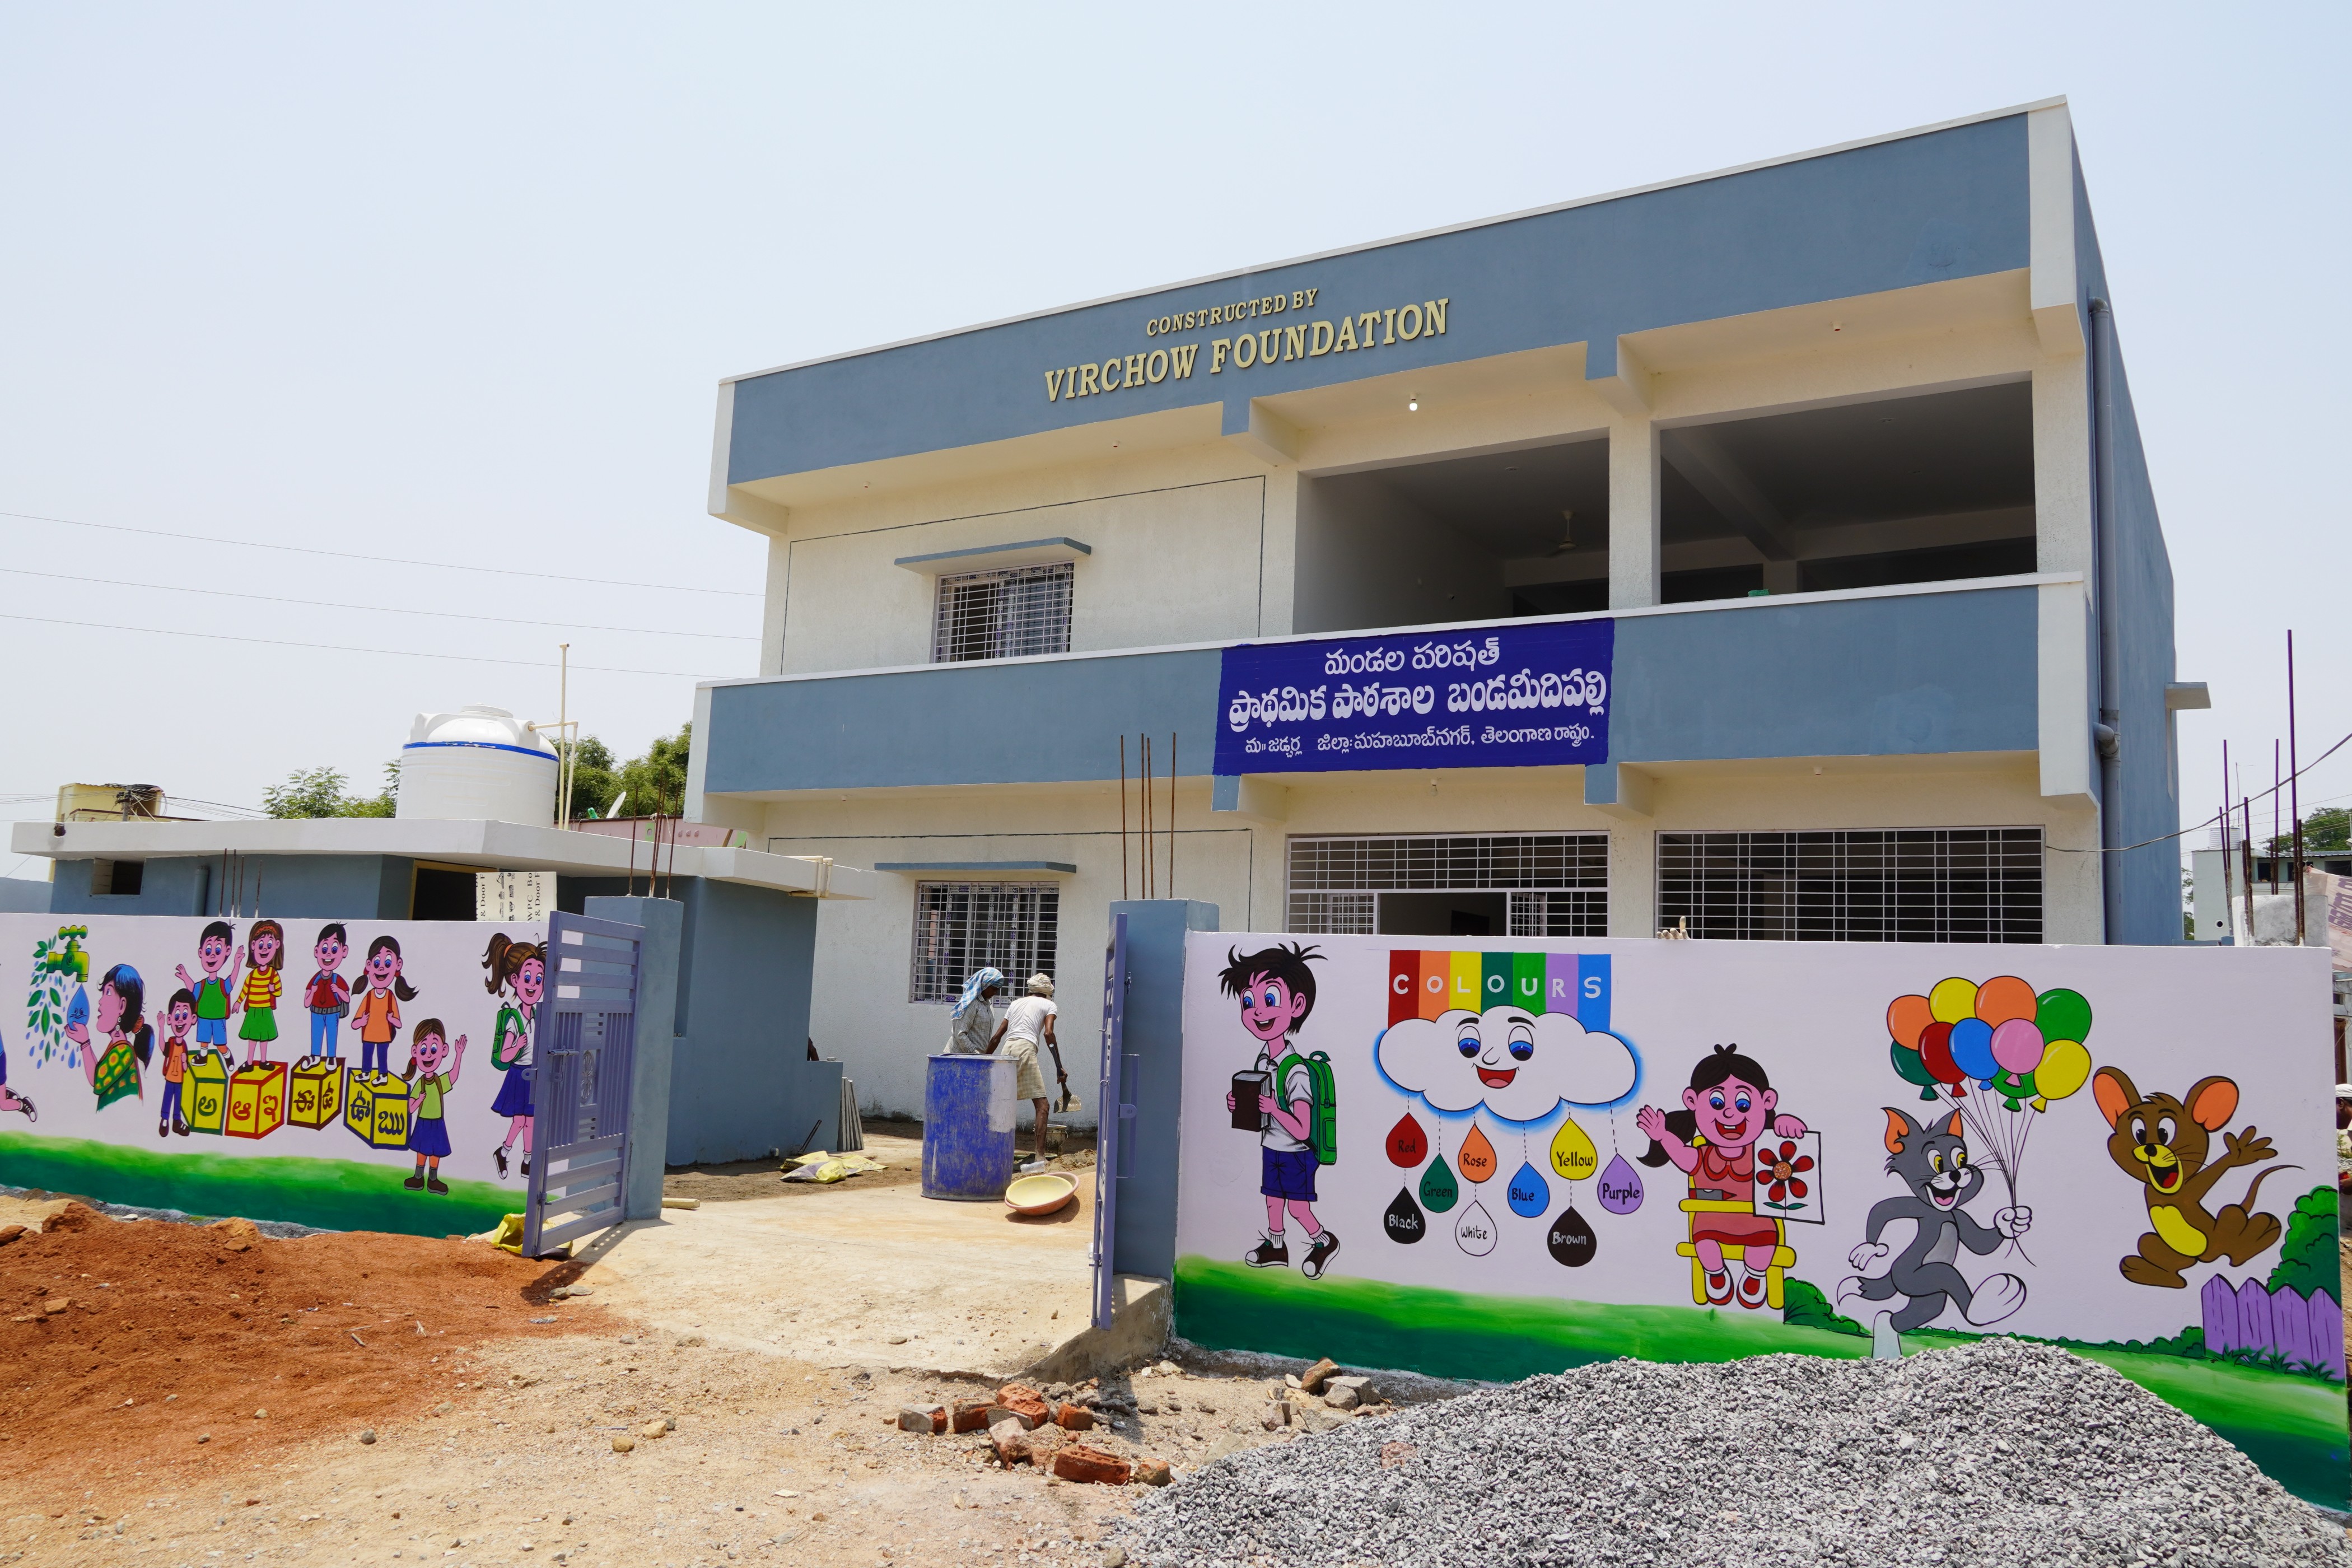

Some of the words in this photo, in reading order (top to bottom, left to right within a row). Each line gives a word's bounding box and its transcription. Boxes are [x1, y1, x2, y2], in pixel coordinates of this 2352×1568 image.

[1146, 294, 1287, 337] CONSTRUCTED
[1292, 288, 1318, 310] BY
[1044, 343, 1199, 402] VIRCHOW
[1210, 297, 1449, 374] FOUNDATION
[1324, 646, 1405, 675] మండల
[1412, 637, 1500, 672] పరిషత్
[1229, 684, 1327, 732] ప్రాథమిక
[1332, 682, 1435, 719] పాఠశాల
[1447, 668, 1607, 716] బండమీదిపల్లి
[1481, 726, 1552, 744] తెలంగాణ
[1393, 973, 1602, 999] COLOURS
[198, 1095, 217, 1117] అ
[232, 1100, 251, 1121] ఆ
[1397, 1138, 1416, 1154] Red
[1463, 1152, 1487, 1168] Rose
[1556, 1150, 1593, 1168] Yellow
[1423, 1180, 1453, 1198] Green
[1511, 1187, 1535, 1202] Blue
[1602, 1181, 1640, 1205] Purple
[1388, 1213, 1419, 1230] Black
[1460, 1225, 1488, 1245] White
[1552, 1231, 1587, 1245] Brown
